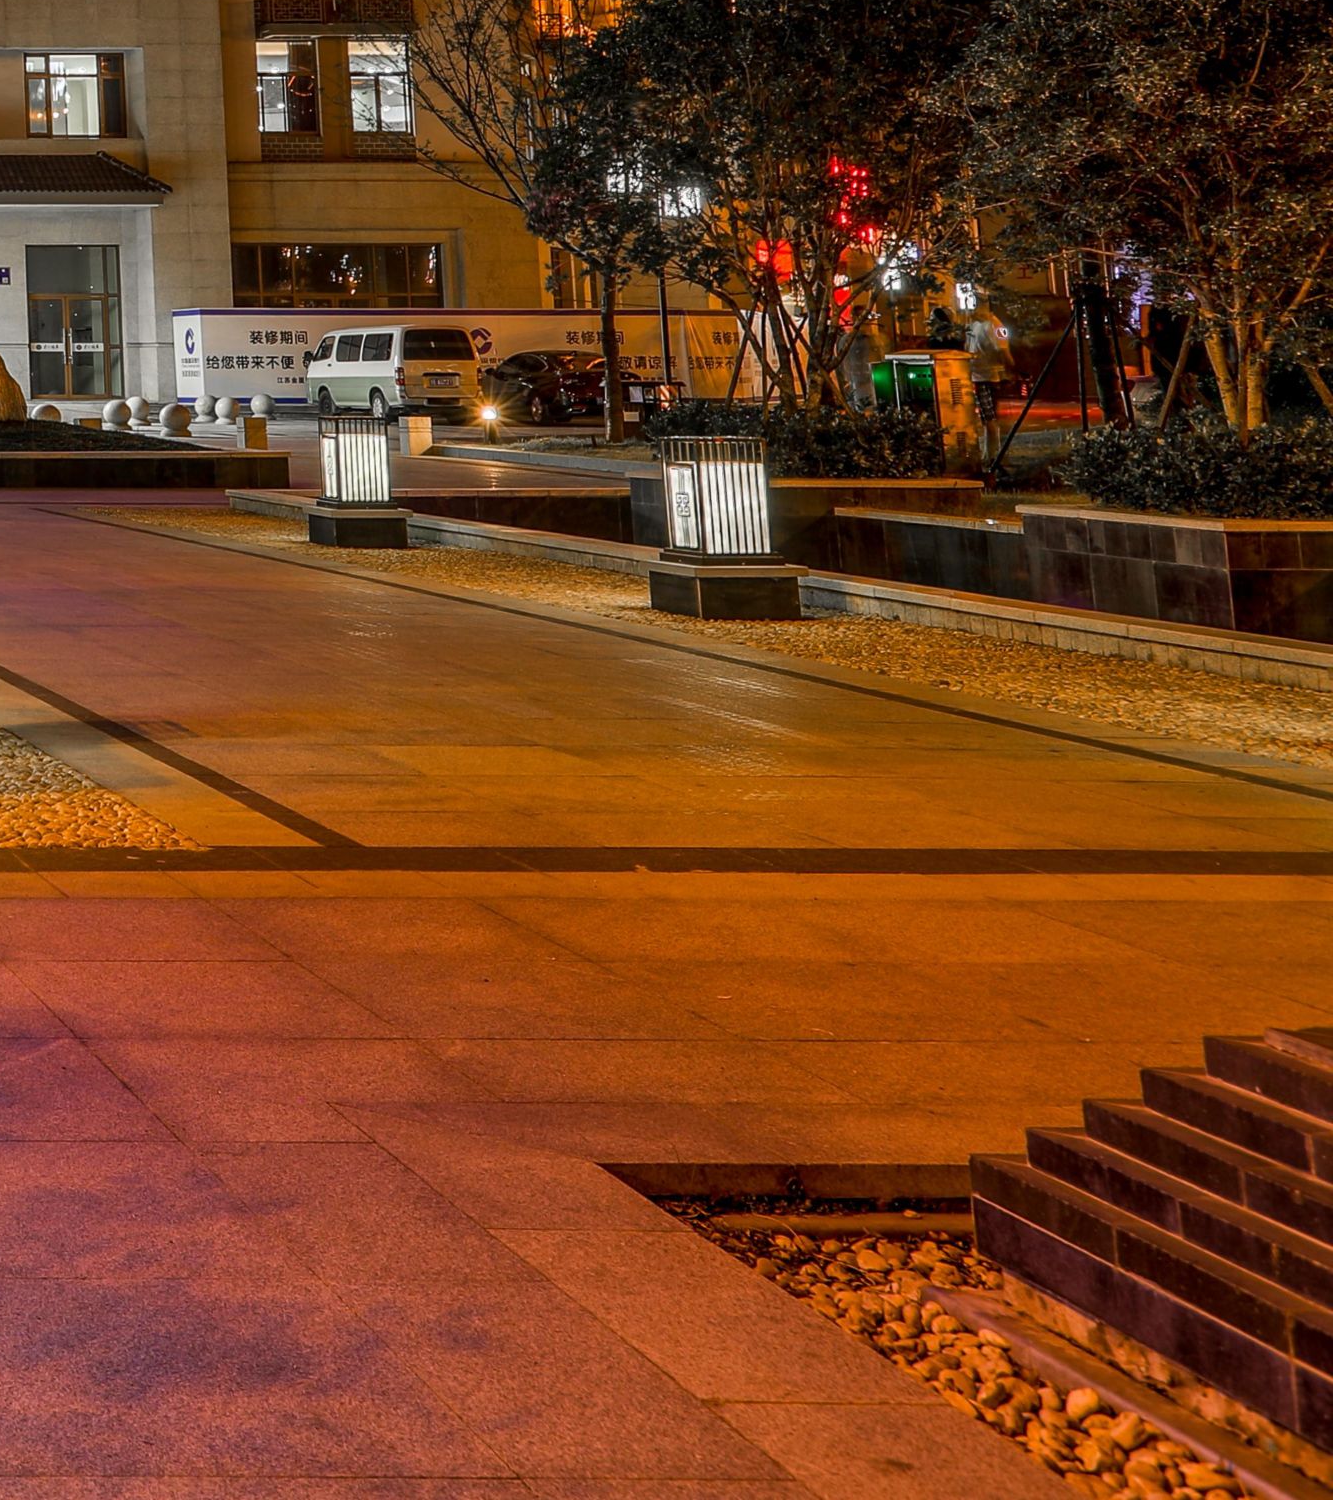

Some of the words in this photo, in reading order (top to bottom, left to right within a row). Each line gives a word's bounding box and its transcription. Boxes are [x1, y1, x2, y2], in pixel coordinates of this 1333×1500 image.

[249, 330, 309, 345] 装修期间
[206, 355, 295, 370] 给您带来不便
